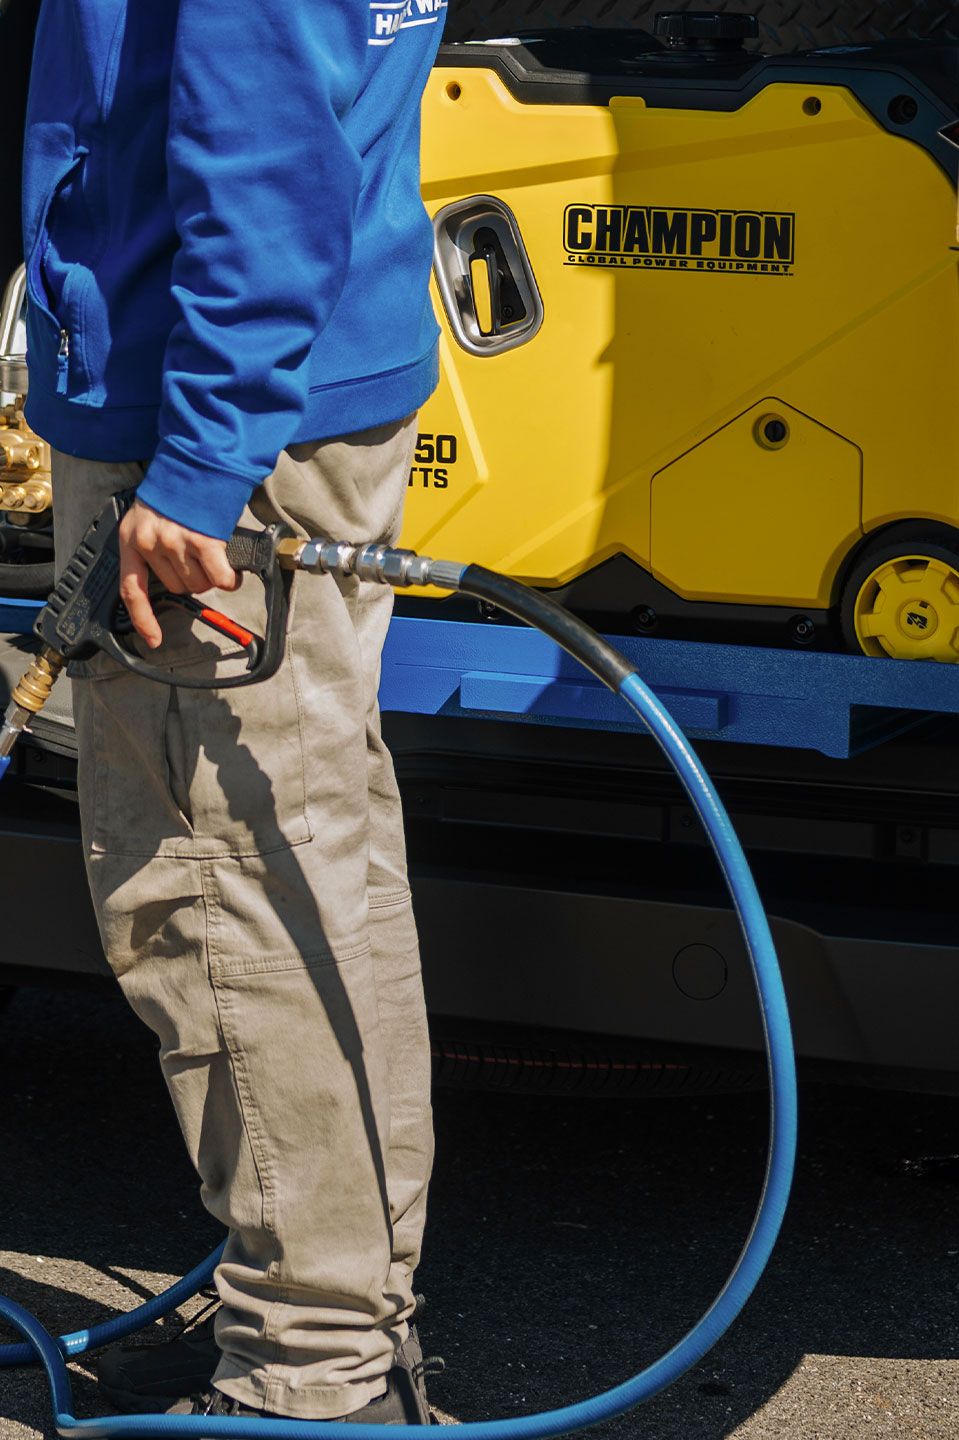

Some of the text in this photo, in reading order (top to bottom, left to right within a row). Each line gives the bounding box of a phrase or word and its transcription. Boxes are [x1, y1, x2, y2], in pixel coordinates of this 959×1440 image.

[568, 208, 790, 260] CHAMPION
[568, 255, 790, 272] GLOBAL POWER EQUIPMENT
[414, 433, 457, 464] 50
[408, 467, 449, 489] TTS
